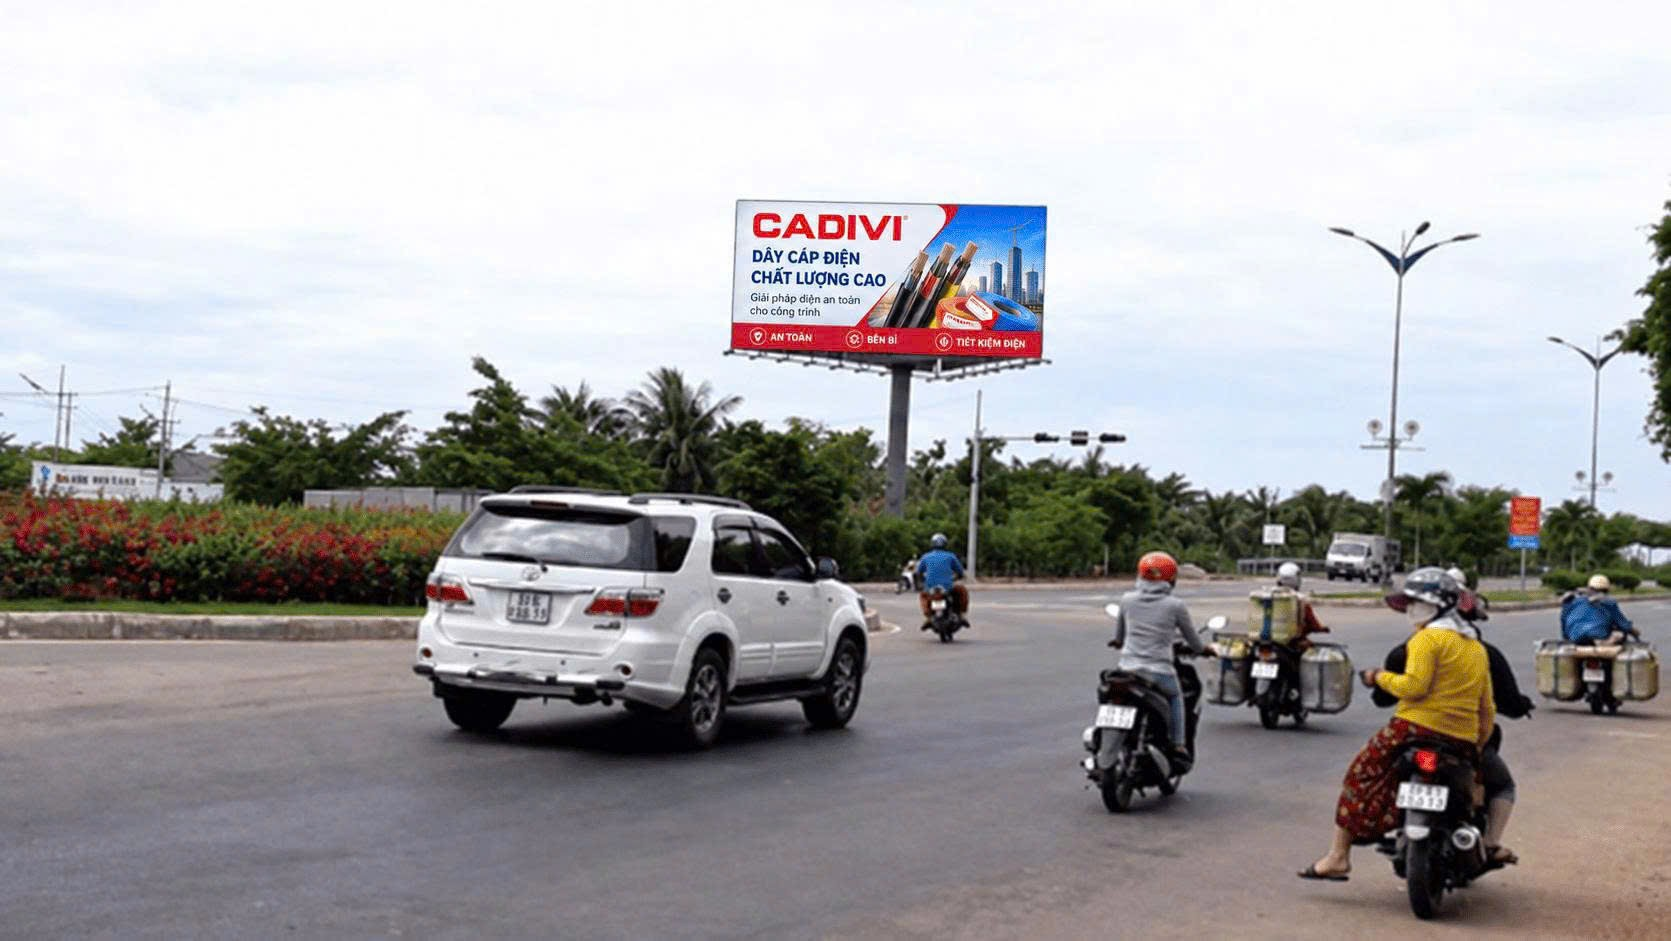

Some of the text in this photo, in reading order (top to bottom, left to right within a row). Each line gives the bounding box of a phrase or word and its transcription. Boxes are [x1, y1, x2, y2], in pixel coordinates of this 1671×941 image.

[753, 213, 902, 241] CADIVI
[753, 247, 860, 268] DÂY CÁP ĐIỆN
[751, 267, 886, 288] CHẤT LƯỢNG CAO
[823, 296, 836, 304] an
[750, 306, 768, 315] cho
[771, 332, 784, 341] AN
